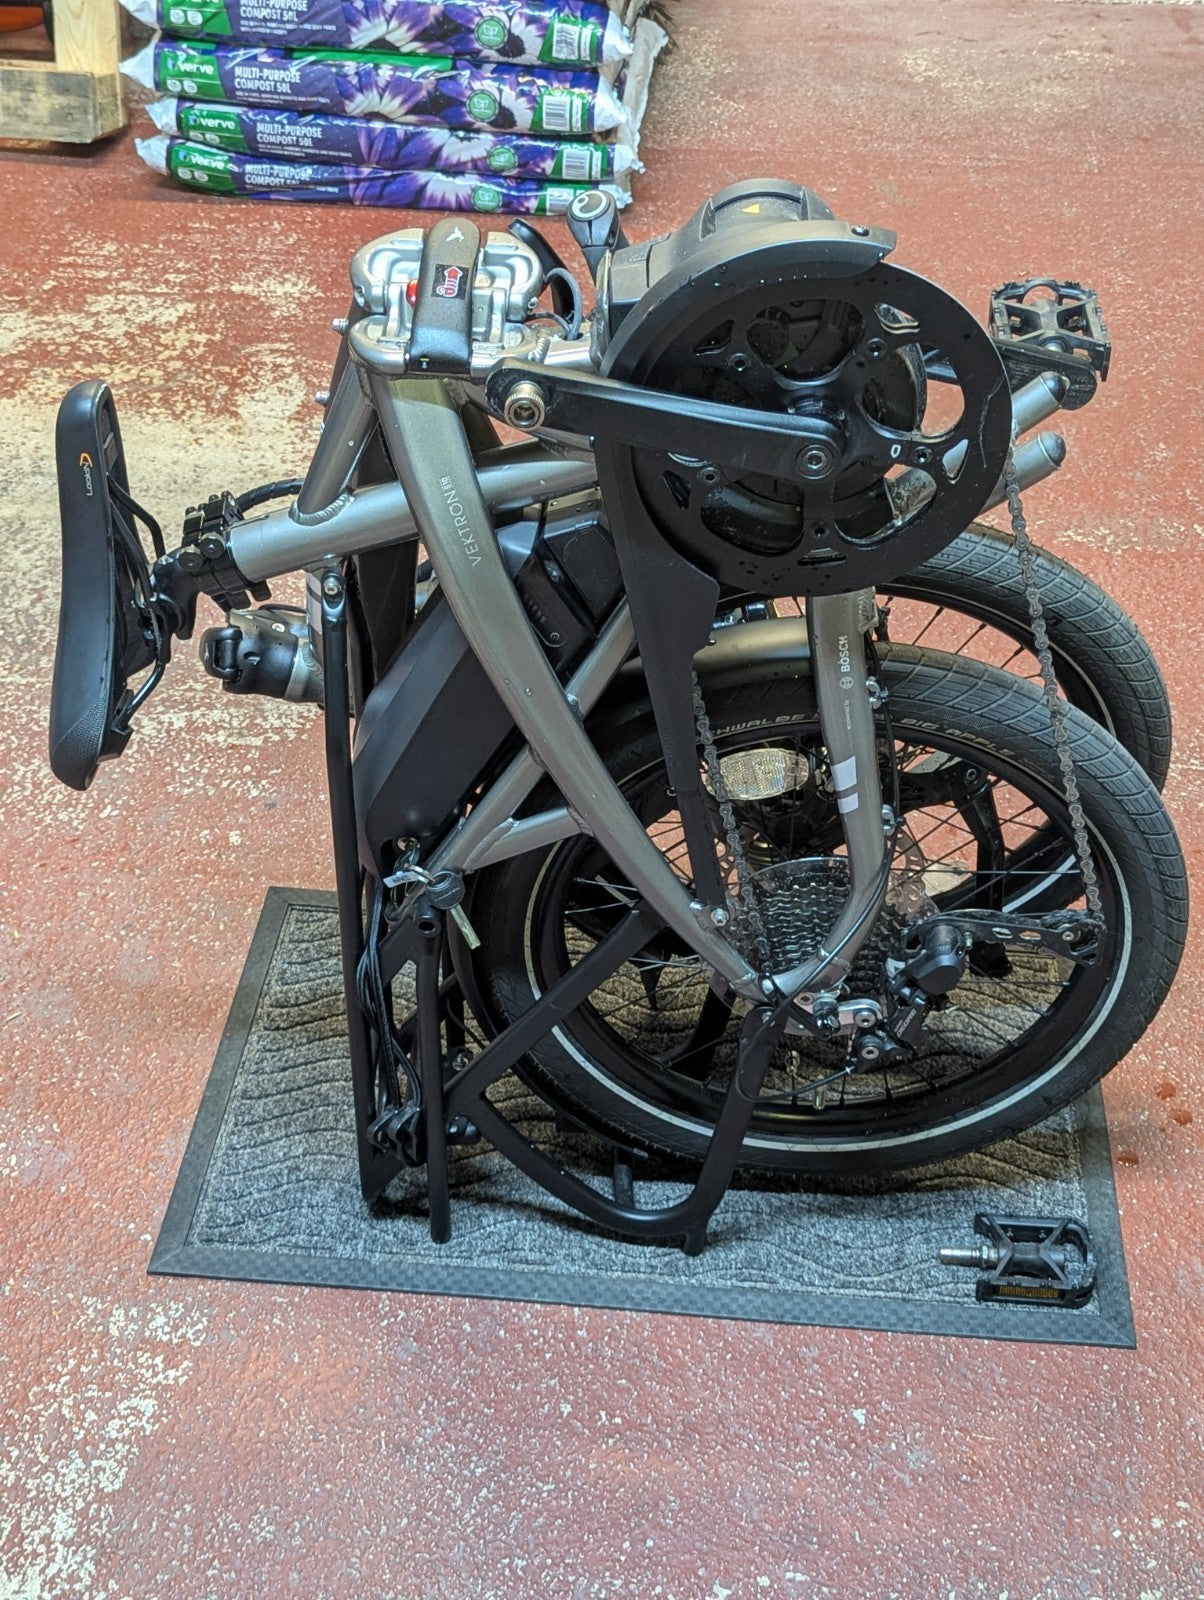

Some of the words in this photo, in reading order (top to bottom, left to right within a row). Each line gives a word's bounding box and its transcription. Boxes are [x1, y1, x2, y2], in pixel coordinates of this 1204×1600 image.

[240, 7, 281, 20] COMPOST
[282, 10, 298, 22] 50L
[179, 63, 214, 75] verve
[234, 66, 301, 83] MULTI-PURPOSE
[234, 78, 275, 92] COMPOST
[276, 82, 292, 93] 50L
[200, 118, 235, 129] verve
[256, 122, 322, 138] MULTI-PURPOSE
[256, 133, 297, 145] COMPOST
[299, 137, 313, 147] 50L
[190, 154, 225, 169] verve
[245, 164, 310, 180] MULTI-PURPOSE
[245, 174, 285, 187] COMPOST
[444, 490, 482, 566] VEKTRON
[838, 635, 851, 673] BOSCH
[711, 713, 806, 735] HWALBE
[899, 717, 940, 730] BIG
[945, 728, 1016, 757] APPLE
